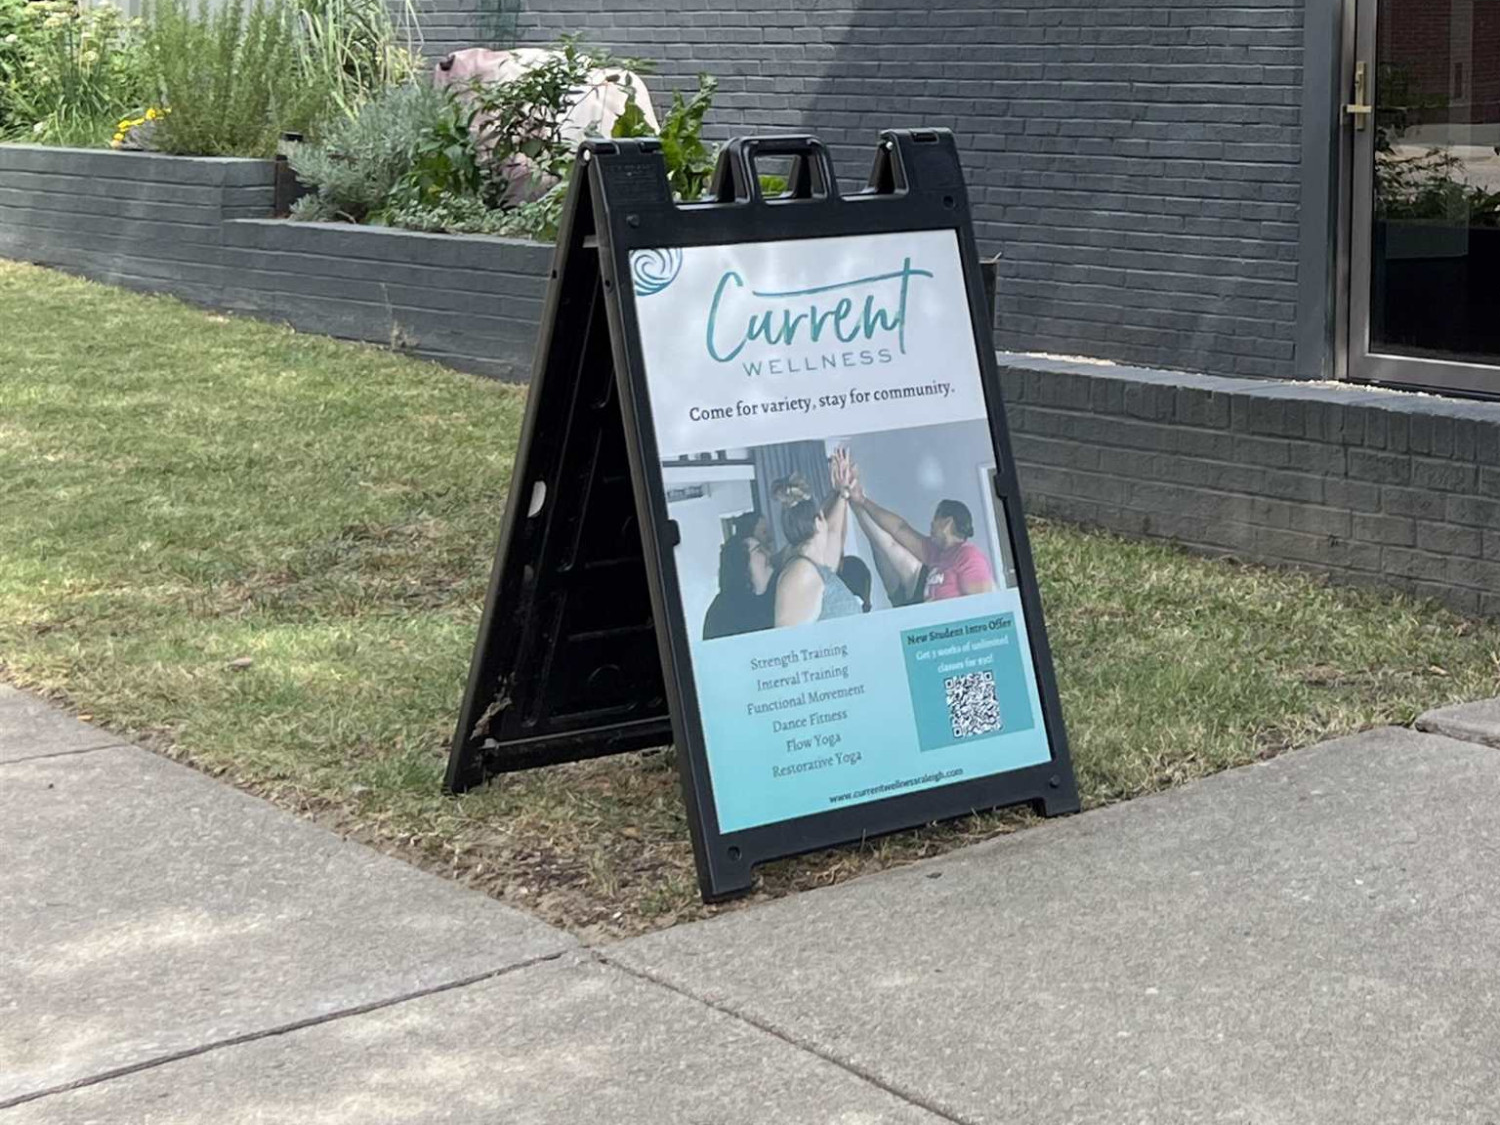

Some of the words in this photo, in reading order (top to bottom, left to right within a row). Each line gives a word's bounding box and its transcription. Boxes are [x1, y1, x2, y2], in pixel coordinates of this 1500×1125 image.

[706, 257, 934, 362] Current
[743, 348, 893, 376] WELLNESS
[689, 406, 733, 421] Come
[736, 399, 758, 416] for
[761, 396, 817, 413] variety,
[819, 393, 846, 409] stay
[850, 387, 871, 403] for
[874, 379, 956, 401] community.
[907, 634, 928, 645] New
[929, 627, 963, 641] Student
[965, 623, 987, 635] Intro
[988, 617, 1012, 630] Offer
[750, 650, 799, 670] Strength
[800, 644, 848, 661] Training
[757, 671, 800, 691] Interval
[801, 665, 849, 683] Training
[747, 693, 806, 715] Functional
[808, 684, 865, 704] Movement
[772, 718, 807, 733] Dance
[809, 710, 848, 726] Fitness
[786, 738, 812, 752] Flow
[813, 733, 842, 747] Yoga
[772, 756, 834, 778] Restorative
[834, 751, 862, 765] Yoga
[828, 768, 964, 803] www.currentwellnessraleigh.com
